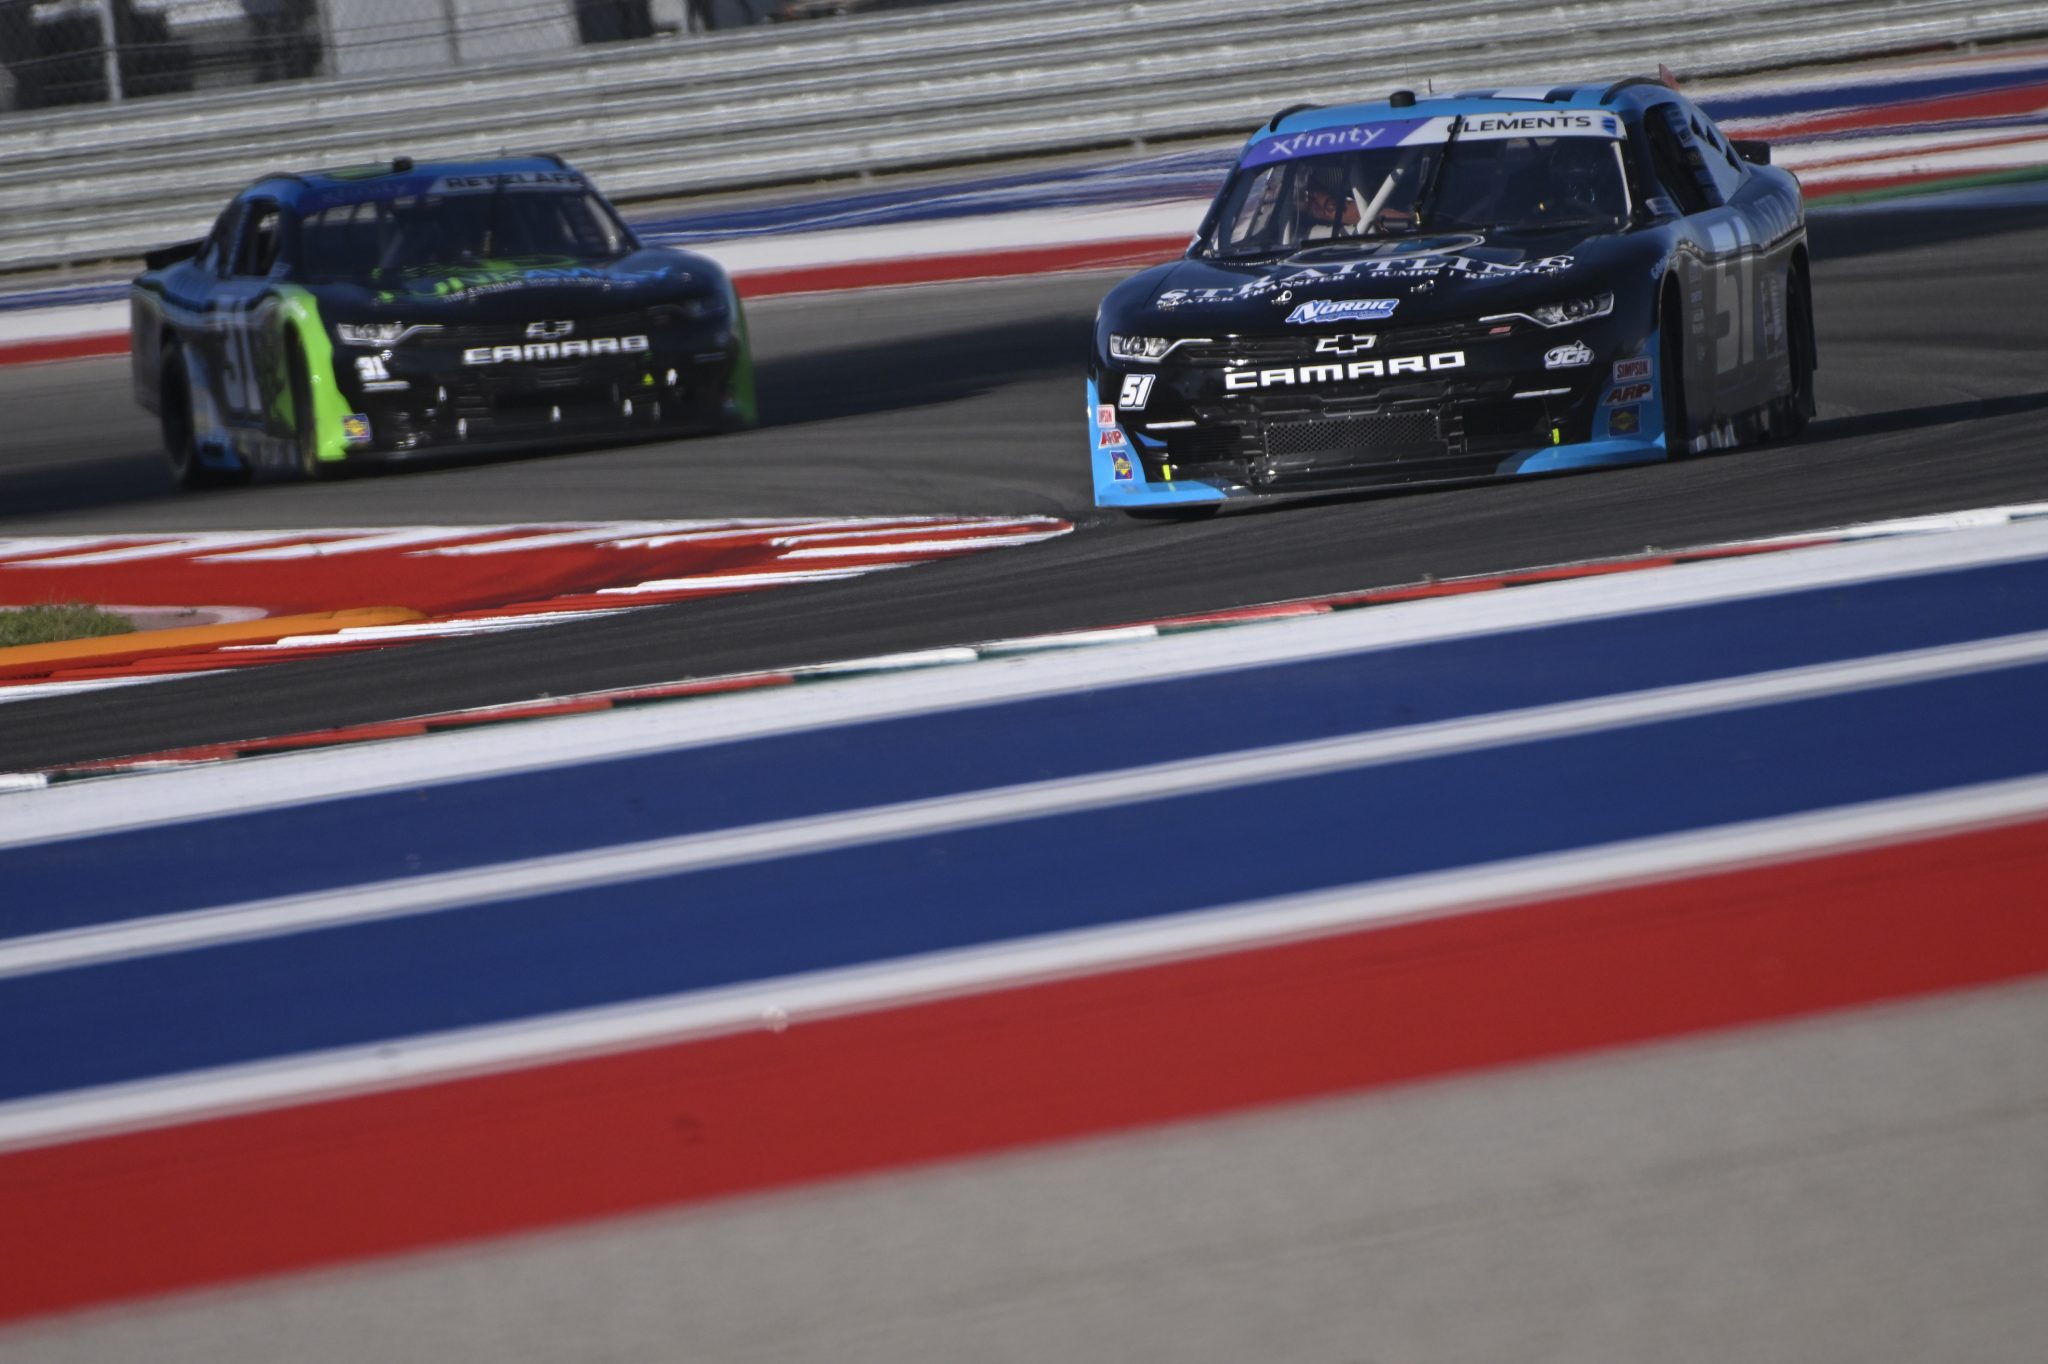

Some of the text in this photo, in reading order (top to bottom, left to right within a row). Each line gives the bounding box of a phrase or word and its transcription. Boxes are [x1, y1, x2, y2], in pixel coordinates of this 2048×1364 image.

[1446, 115, 1592, 134] CLEMENTS
[1268, 127, 1386, 156] xfinity
[1369, 267, 1440, 279] PUMPS
[462, 335, 649, 365] CAMARO
[1225, 351, 1466, 390] CAMARO
[1616, 360, 1650, 378] SIMPSON
[1119, 374, 1156, 411] 51
[1605, 383, 1651, 403] ARP
